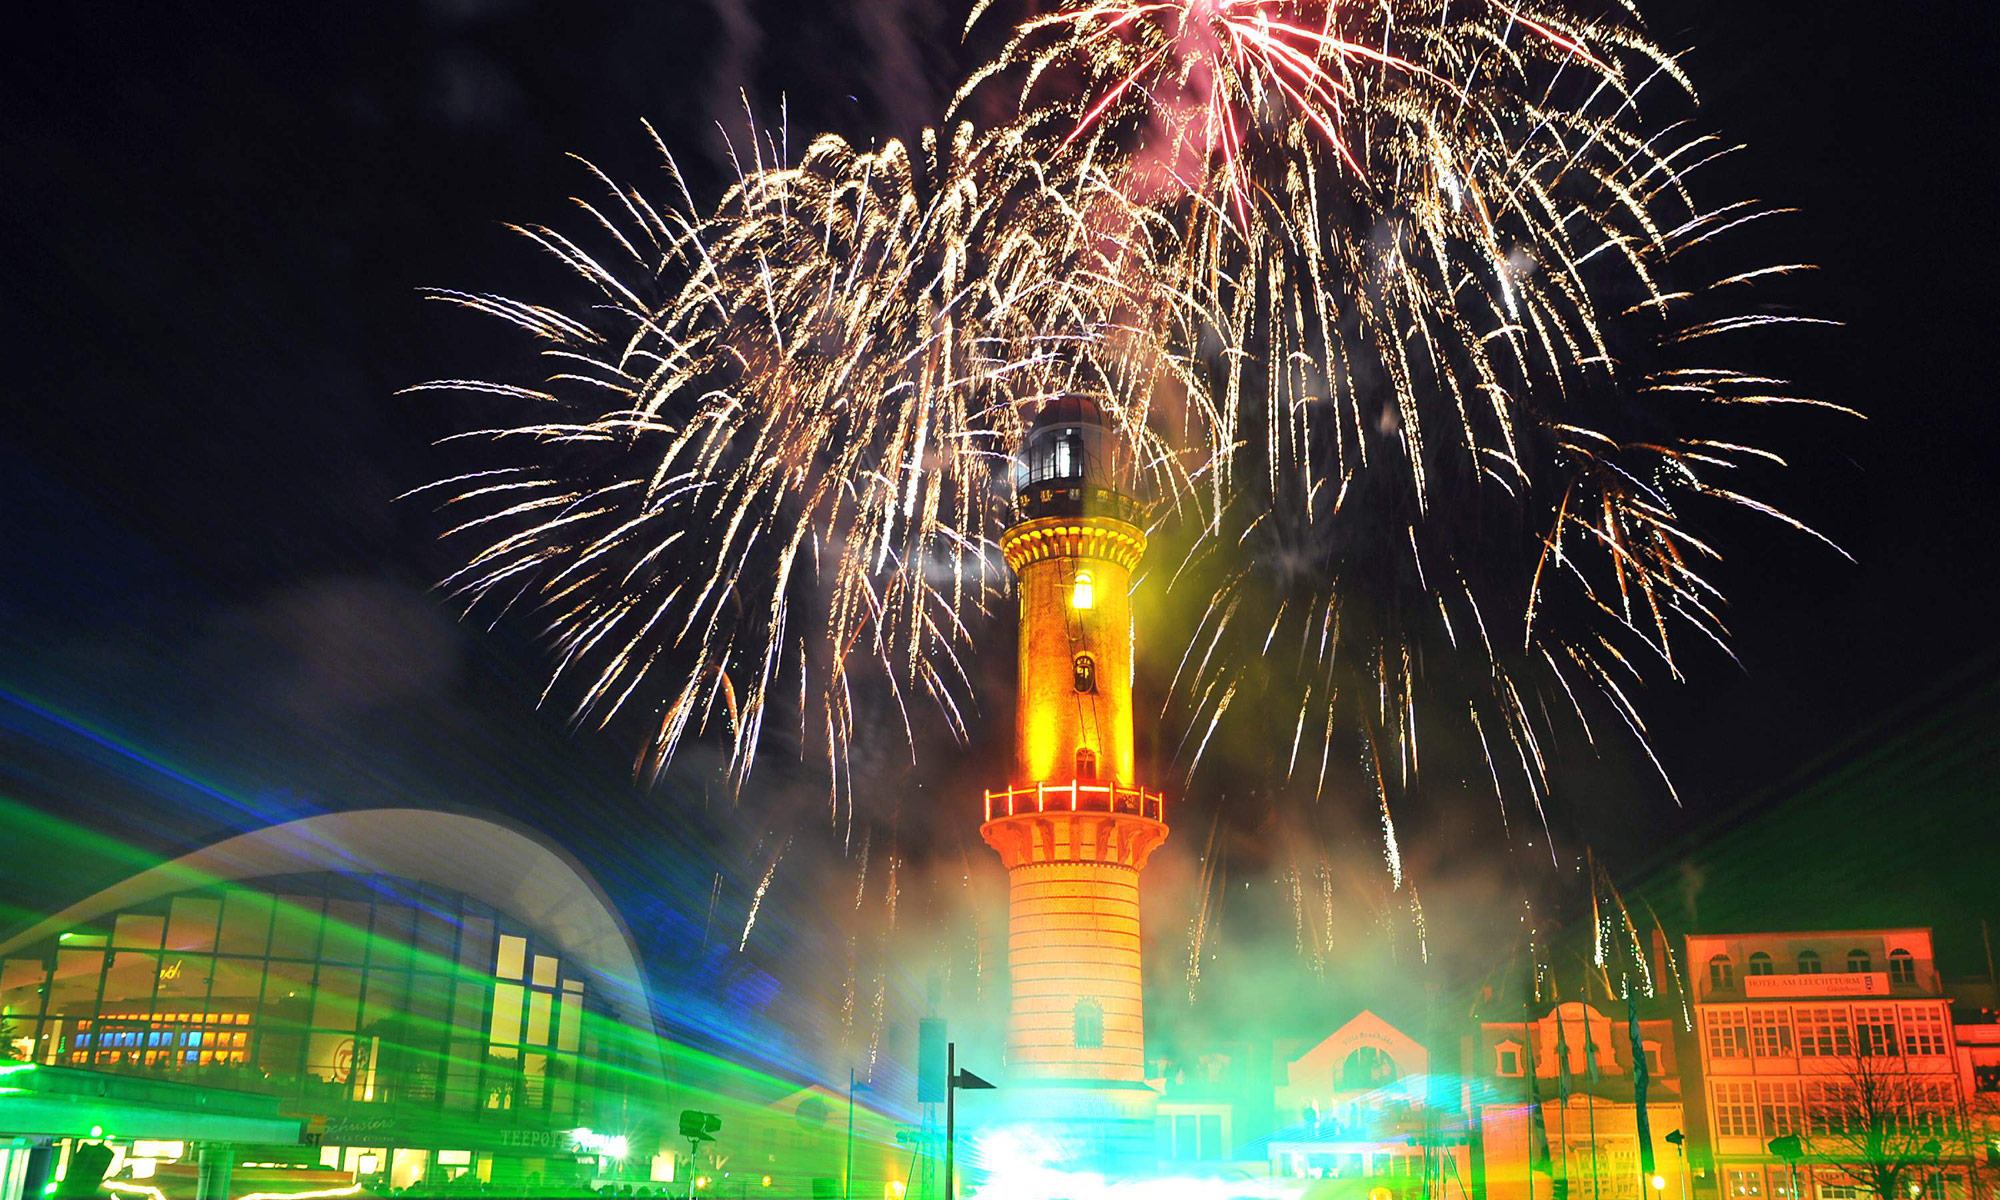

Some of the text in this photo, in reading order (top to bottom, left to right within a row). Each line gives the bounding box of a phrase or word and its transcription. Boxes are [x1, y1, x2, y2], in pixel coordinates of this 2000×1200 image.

[1748, 977, 1861, 987] HOTEL AM LEUCHTTURM
